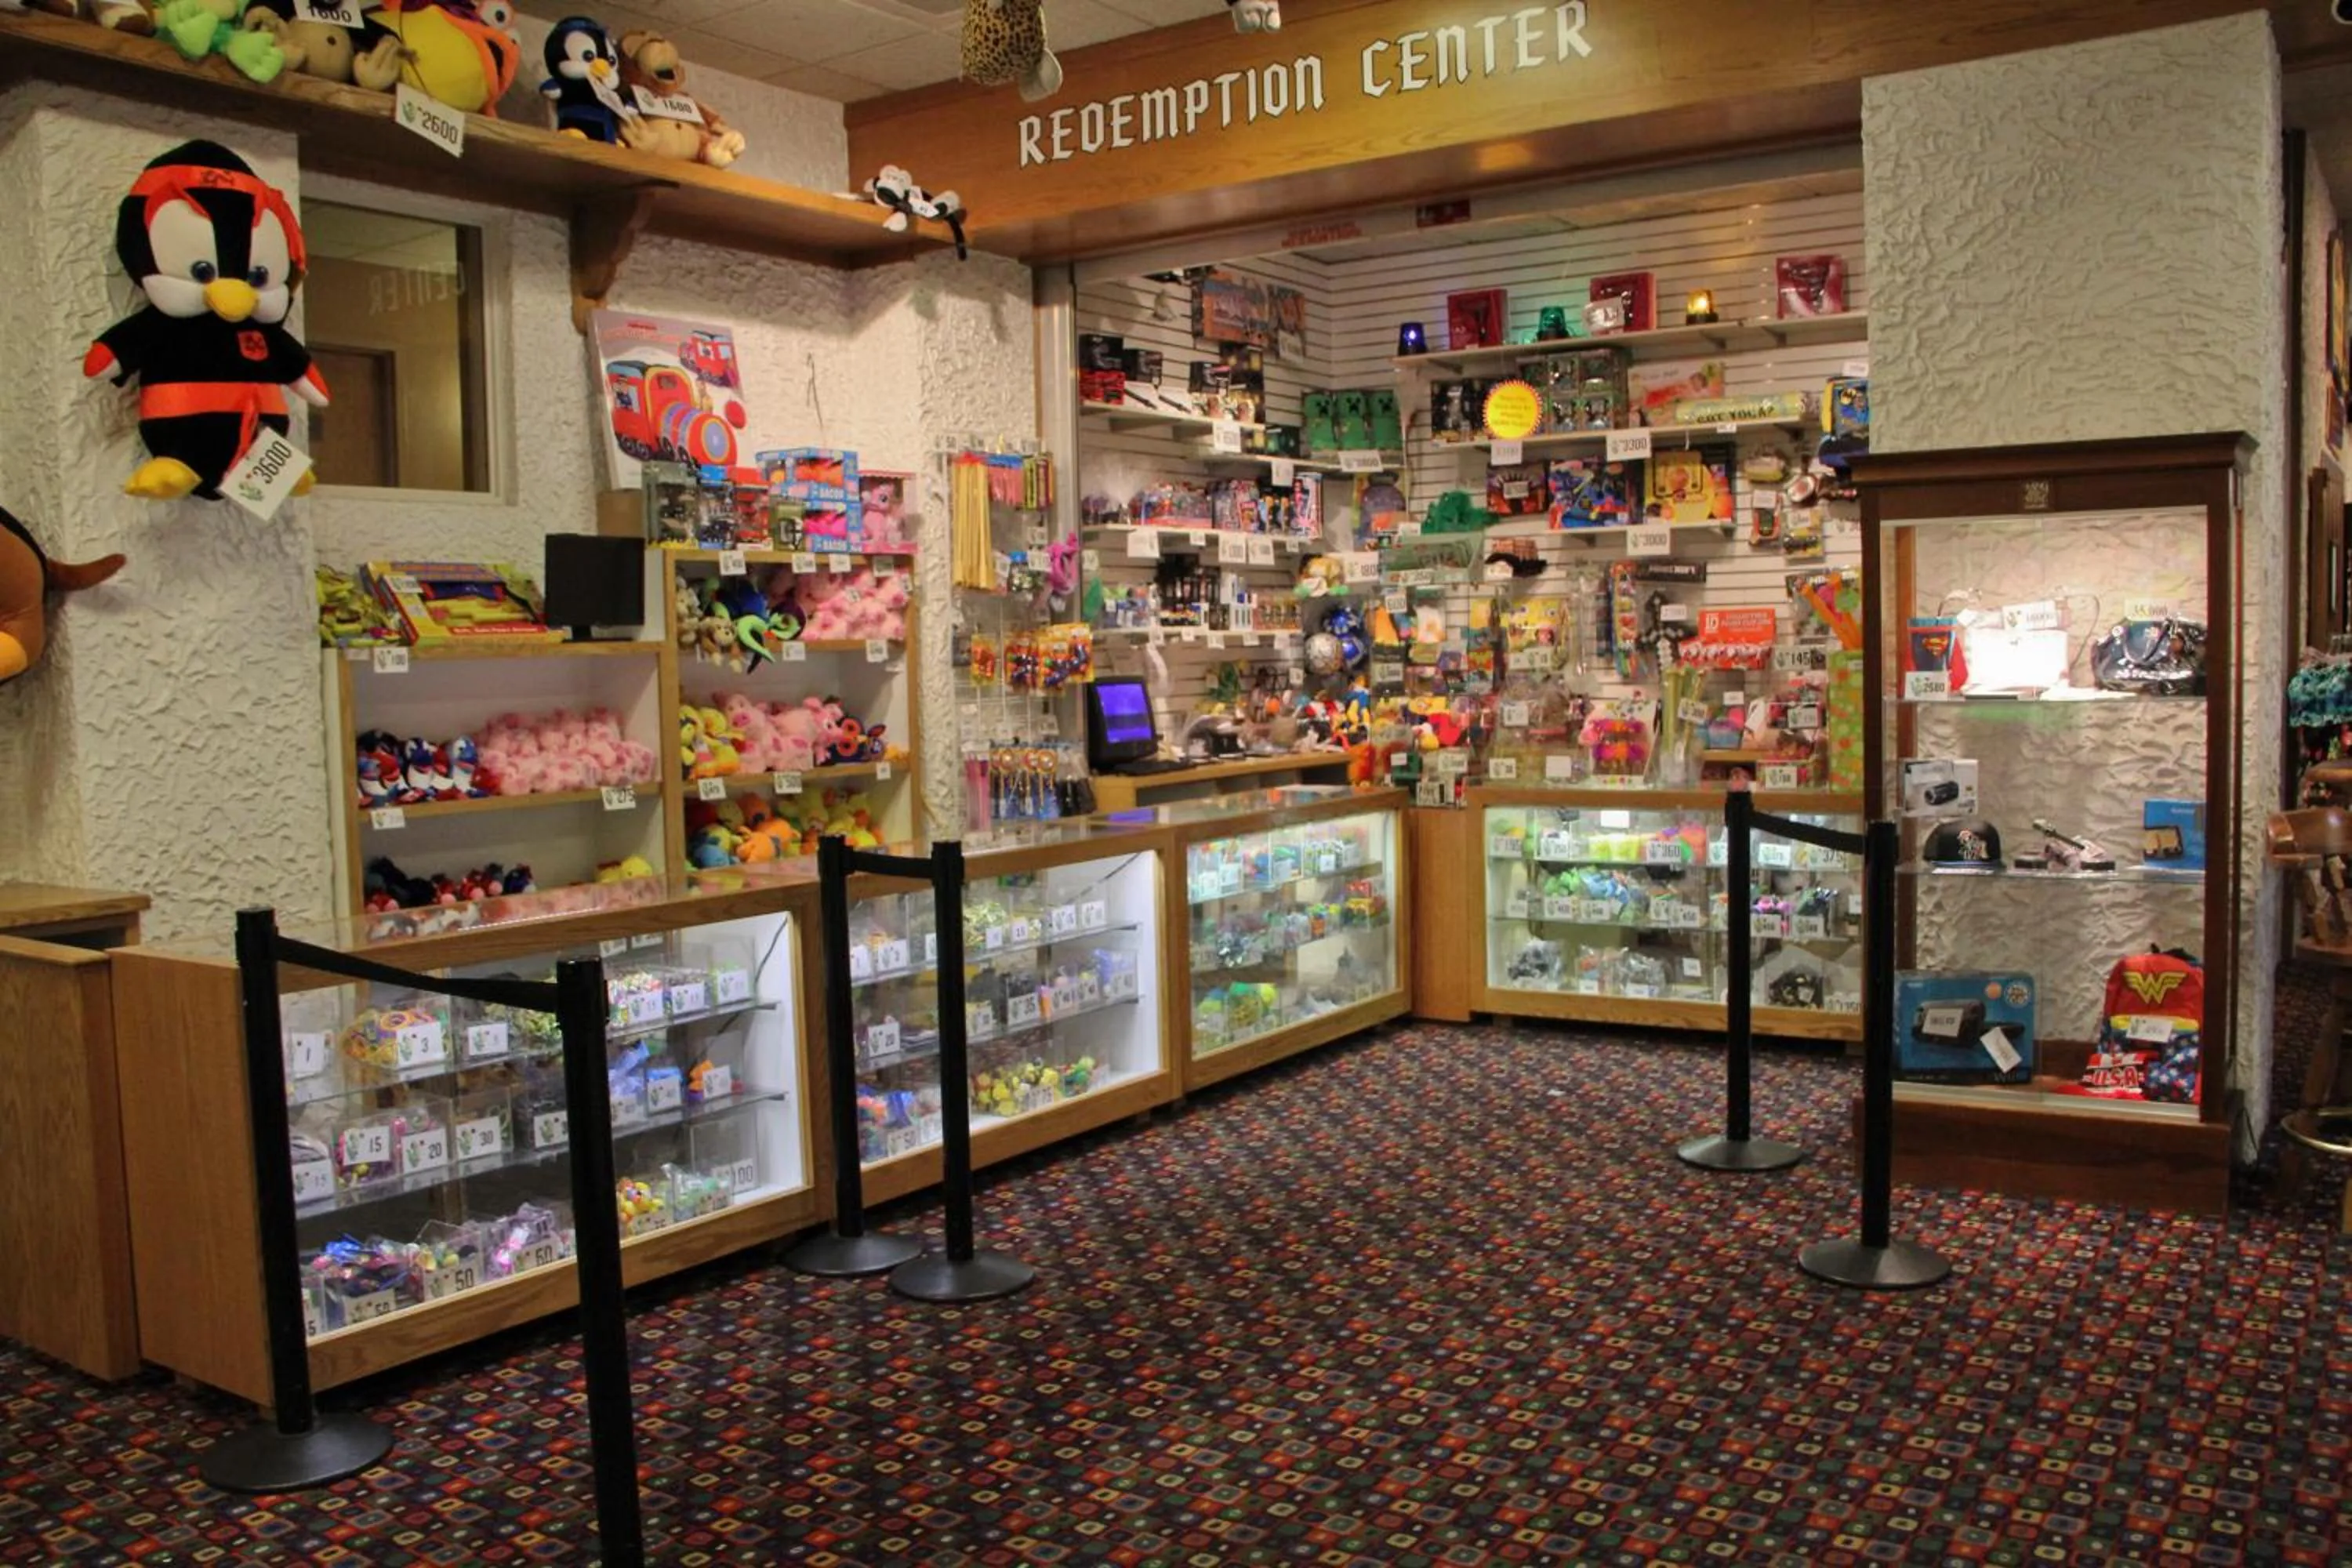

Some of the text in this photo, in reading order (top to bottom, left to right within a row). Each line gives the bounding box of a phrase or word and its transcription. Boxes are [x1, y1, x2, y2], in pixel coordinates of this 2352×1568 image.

[1018, 0, 1593, 167] REDEMPTION CENTER
[421, 111, 459, 144] 2600
[254, 438, 293, 486] 3600
[369, 1135, 382, 1153] 15
[428, 1142, 442, 1160] 20
[454, 1267, 474, 1292] 50
